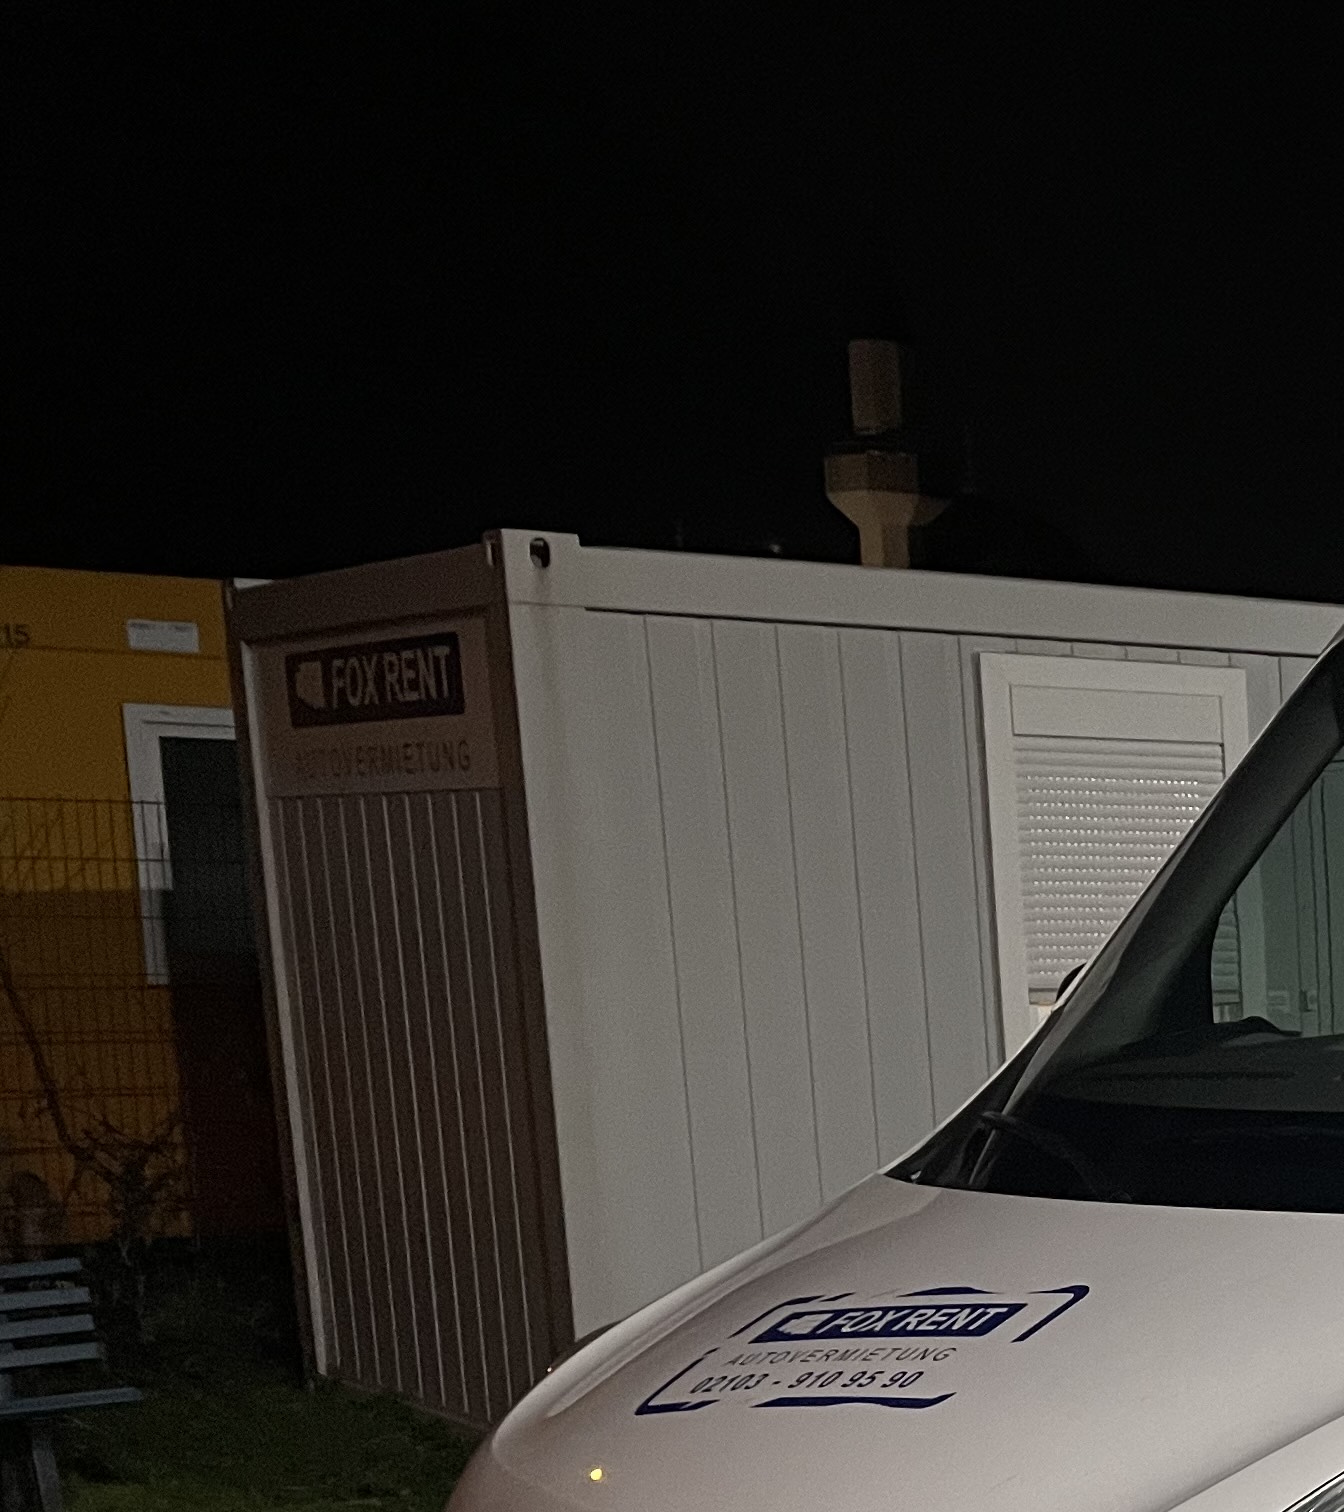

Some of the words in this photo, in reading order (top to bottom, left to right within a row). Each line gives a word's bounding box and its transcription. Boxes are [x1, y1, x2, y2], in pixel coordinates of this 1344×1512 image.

[331, 652, 380, 710] FOX
[382, 645, 451, 703] RENT
[294, 739, 472, 779] AUTOVERMIETUNG
[815, 1309, 912, 1335] FOX
[891, 1307, 1009, 1331] RENT
[724, 1347, 957, 1366] AUTOVERMIETUNG
[689, 1373, 769, 1394] 02103
[787, 1370, 844, 1388] 910
[841, 1370, 885, 1388] 95
[880, 1370, 925, 1388] 90
